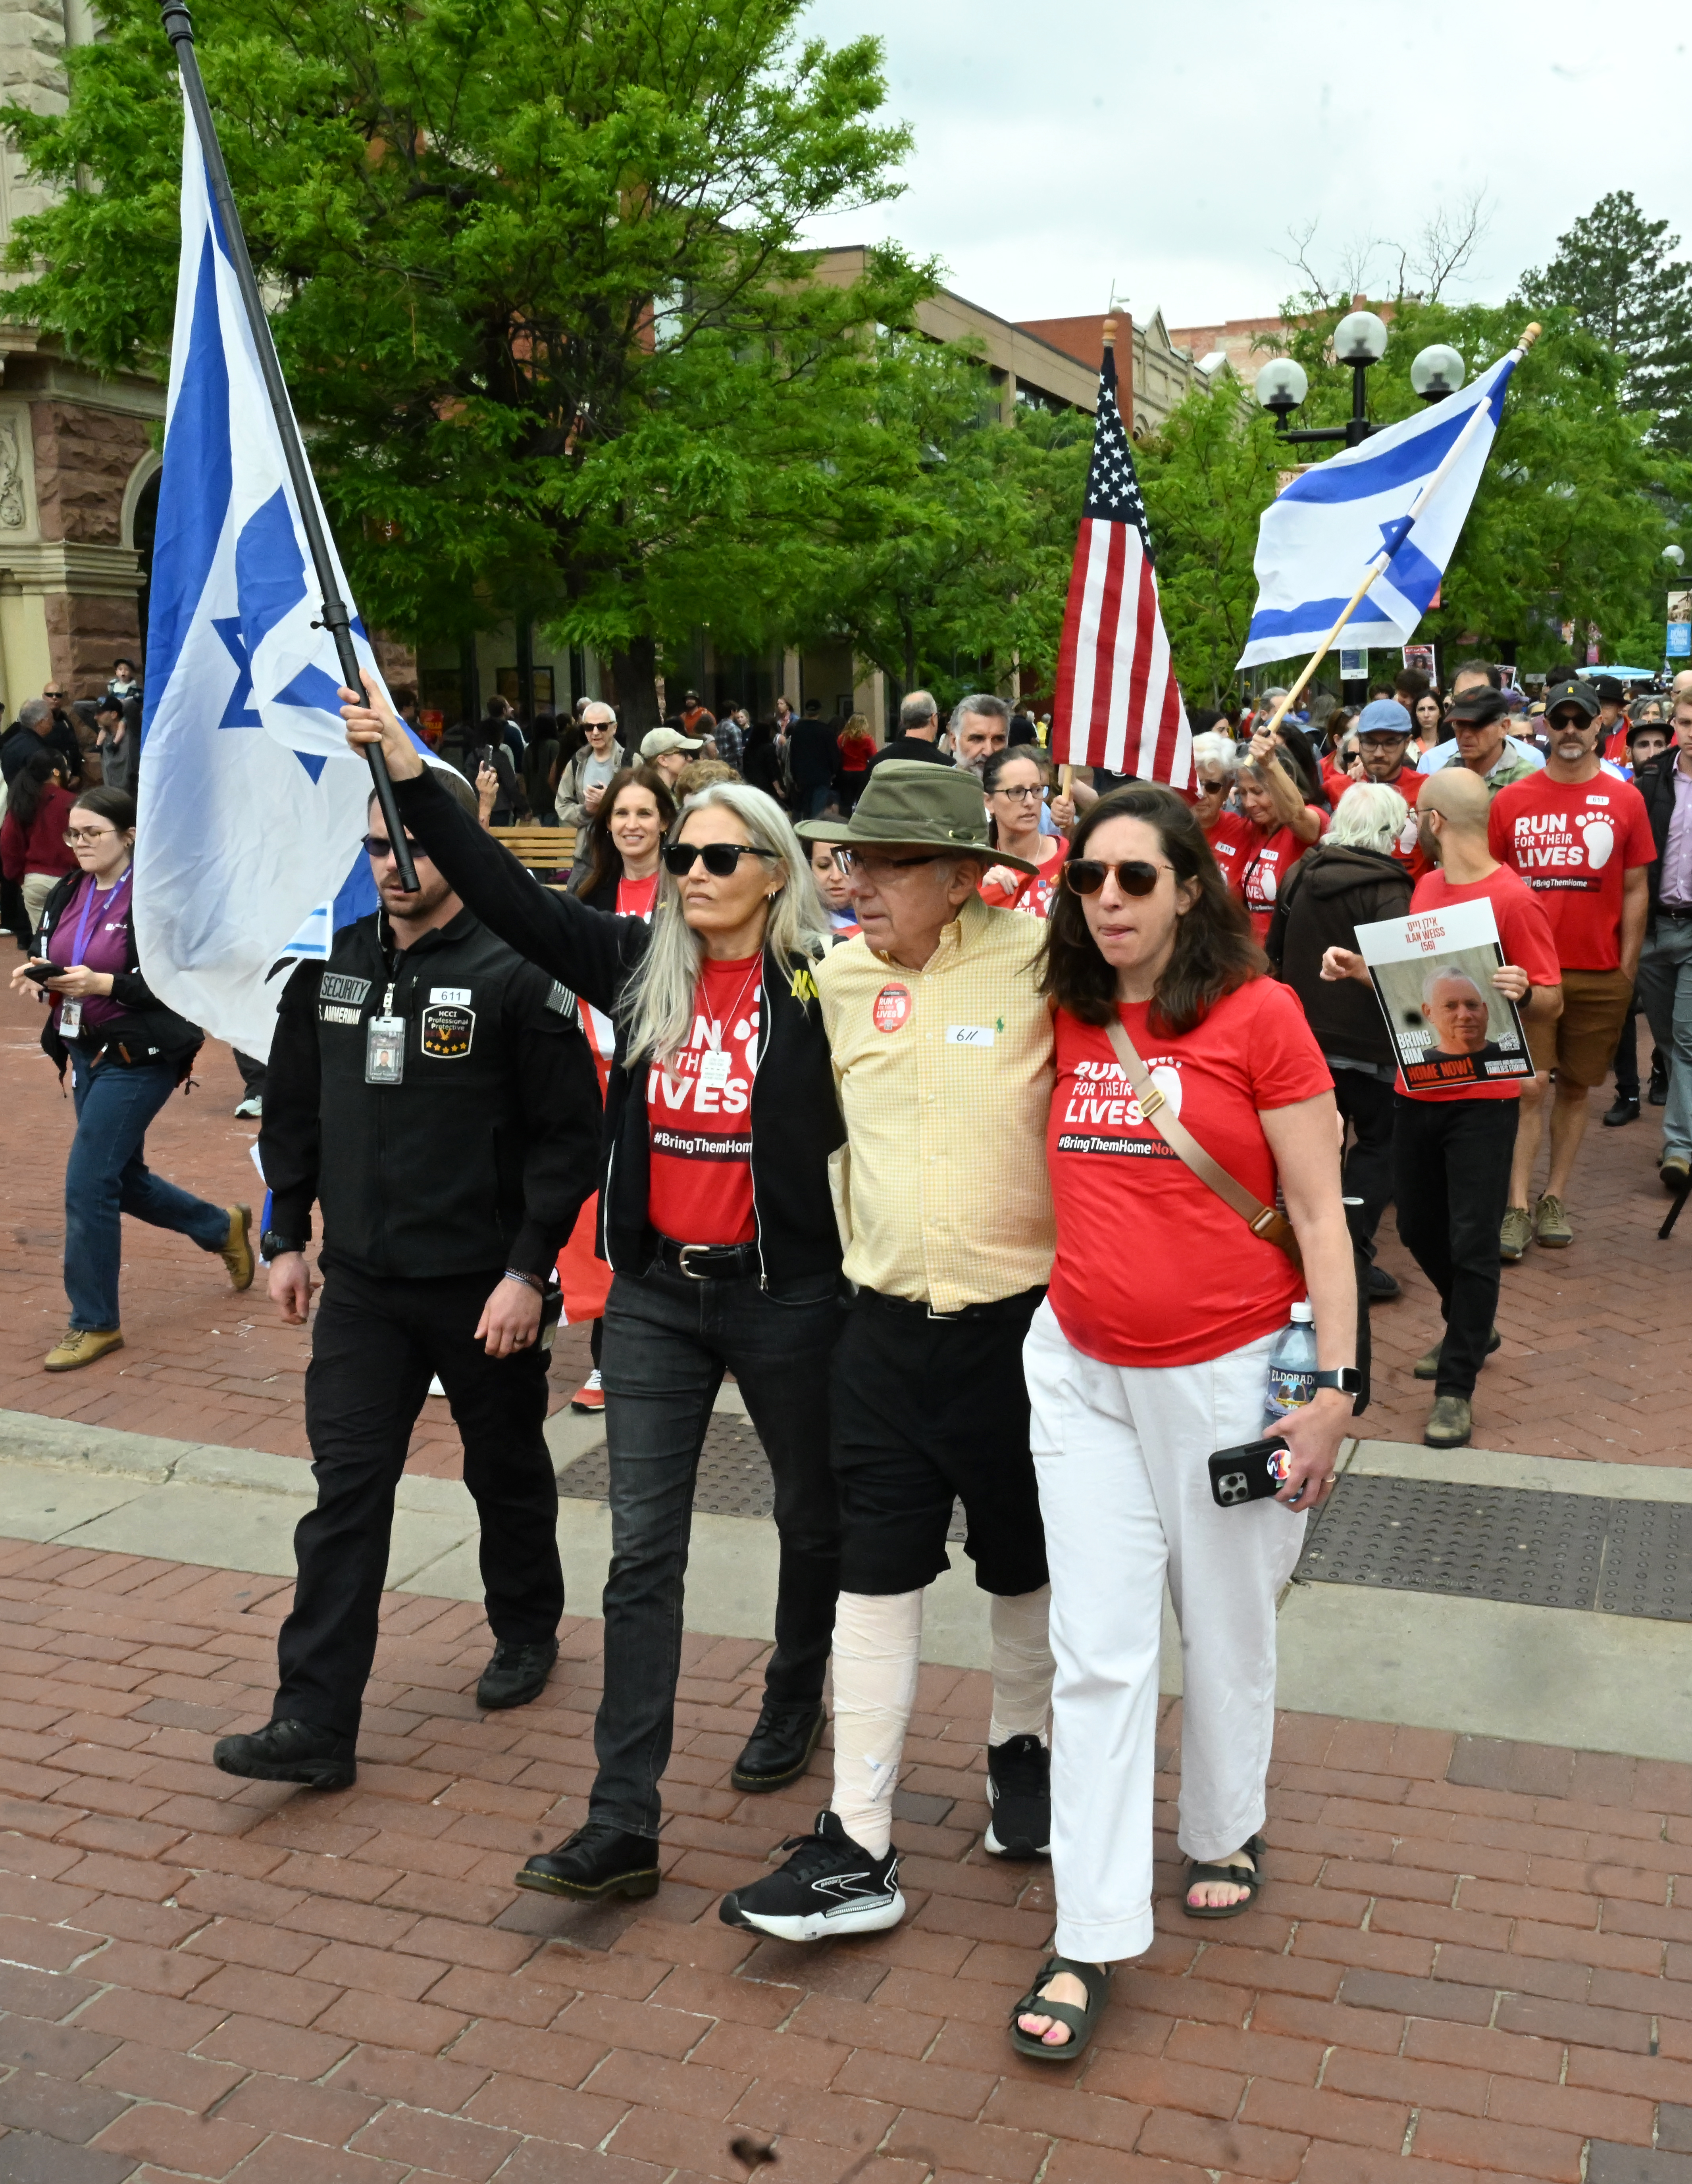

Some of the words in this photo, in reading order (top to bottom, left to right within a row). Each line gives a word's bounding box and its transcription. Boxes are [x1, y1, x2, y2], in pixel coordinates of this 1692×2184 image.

[1515, 813, 1567, 836] RUN
[1515, 835, 1535, 848] FOR
[1539, 833, 1573, 845] THEIR
[1516, 846, 1584, 868] LIVES
[1405, 932, 1422, 943] ILAN
[1422, 927, 1446, 940] WEISS
[1421, 940, 1436, 953] (56)
[321, 975, 369, 1002] SECURITY
[441, 991, 461, 1002] 611
[324, 1005, 362, 1025] AMMERMAN
[428, 1016, 468, 1025] Professional
[876, 1010, 897, 1019] LIVES
[956, 1028, 978, 1041] 611
[1396, 1029, 1432, 1049] BRING
[1401, 1047, 1425, 1065] HIM
[1406, 1063, 1440, 1082] HOME
[1440, 1057, 1474, 1077] NOW!
[645, 1069, 749, 1114] IVES
[1072, 1082, 1096, 1096] FOR
[1099, 1082, 1133, 1096] THEIR
[1064, 1099, 1144, 1125] LIVES
[653, 1132, 752, 1154] #BringThemHom
[1271, 1369, 1315, 1385] ELDORAD
